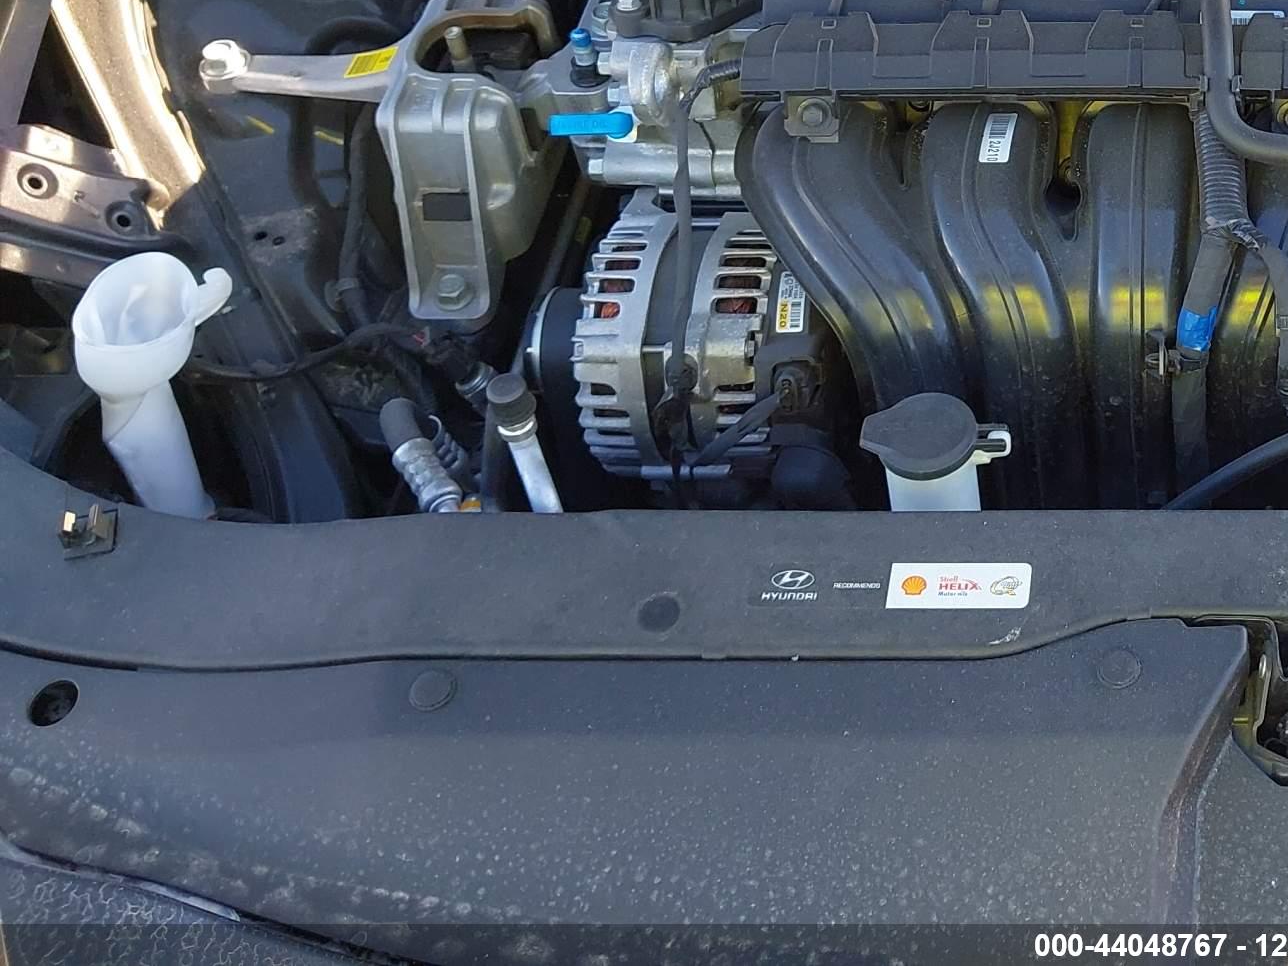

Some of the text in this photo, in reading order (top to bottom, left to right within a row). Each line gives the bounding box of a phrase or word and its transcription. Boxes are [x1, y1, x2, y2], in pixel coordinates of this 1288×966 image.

[779, 303, 788, 328] N20
[940, 575, 959, 583] Shell
[938, 582, 980, 591] HELIX
[761, 592, 818, 601] HYUNDAI
